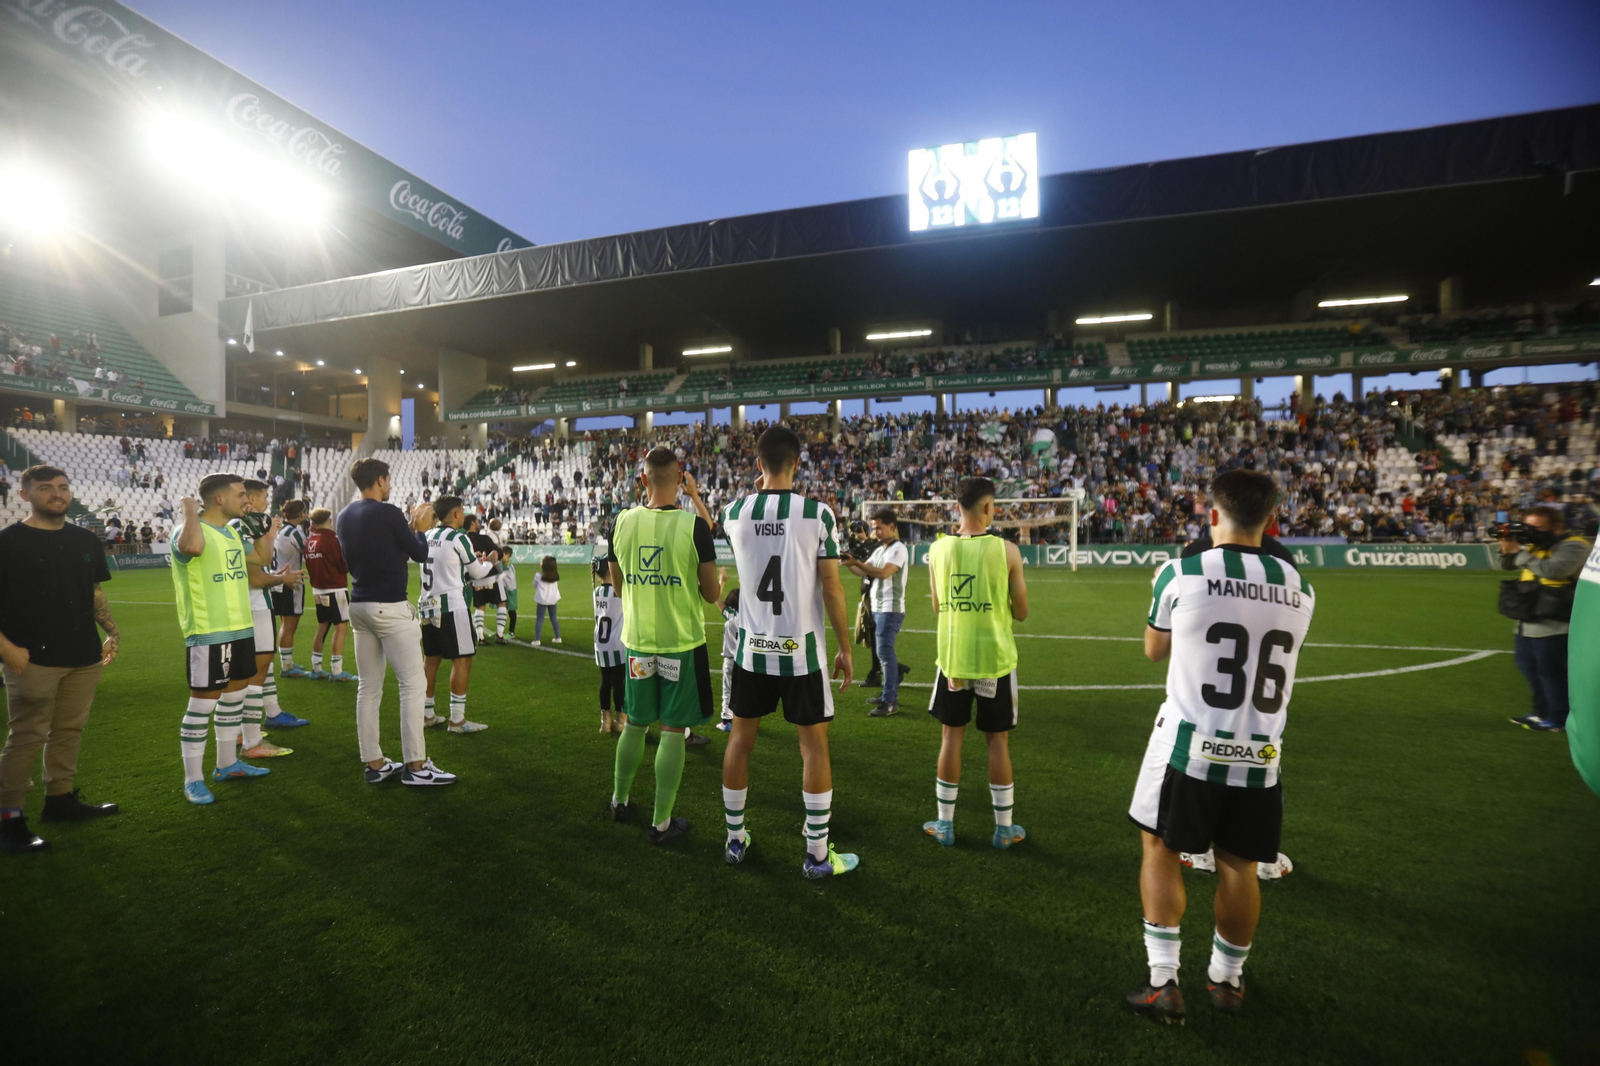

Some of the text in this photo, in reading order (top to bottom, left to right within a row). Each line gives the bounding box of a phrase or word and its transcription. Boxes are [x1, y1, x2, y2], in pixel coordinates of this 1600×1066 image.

[931, 205, 953, 226] 12
[996, 197, 1020, 219] 12
[858, 383, 886, 391] SILBON
[896, 380, 925, 388] SILBON
[448, 406, 517, 420] tienda.cordobacf.com
[754, 523, 785, 536] VISUS
[1069, 550, 1171, 565] GIVOVA
[1345, 547, 1468, 570] Cruzcampo
[626, 573, 682, 588] GIVOVA
[756, 555, 784, 616] 4
[1207, 579, 1301, 609] MANOLILLO
[221, 643, 232, 664] 14
[1201, 621, 1294, 715] 36
